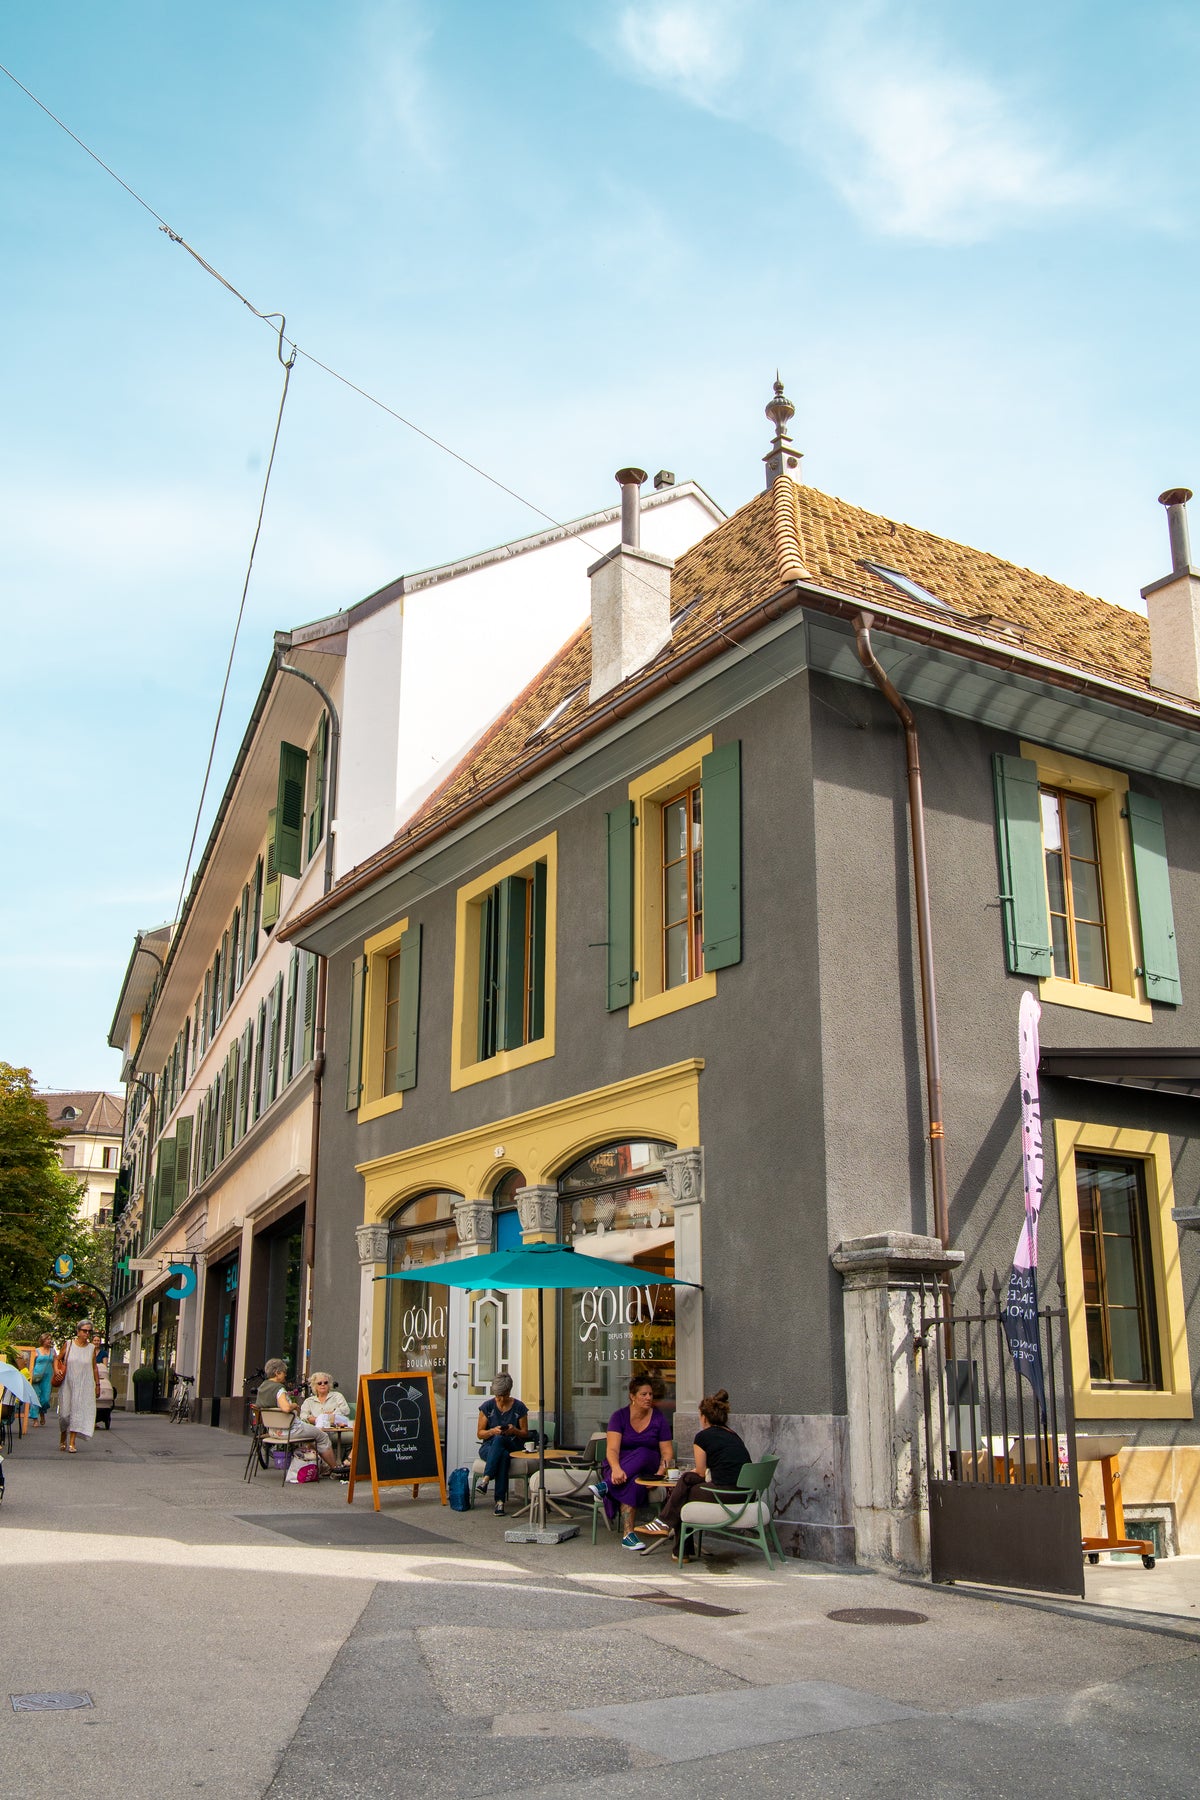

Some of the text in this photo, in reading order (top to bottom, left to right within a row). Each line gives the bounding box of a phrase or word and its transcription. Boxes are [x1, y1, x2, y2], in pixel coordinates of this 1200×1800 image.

[401, 1296, 448, 1352] gola
[579, 1284, 660, 1342] golay
[587, 1348, 654, 1362] PÂTISSIERS
